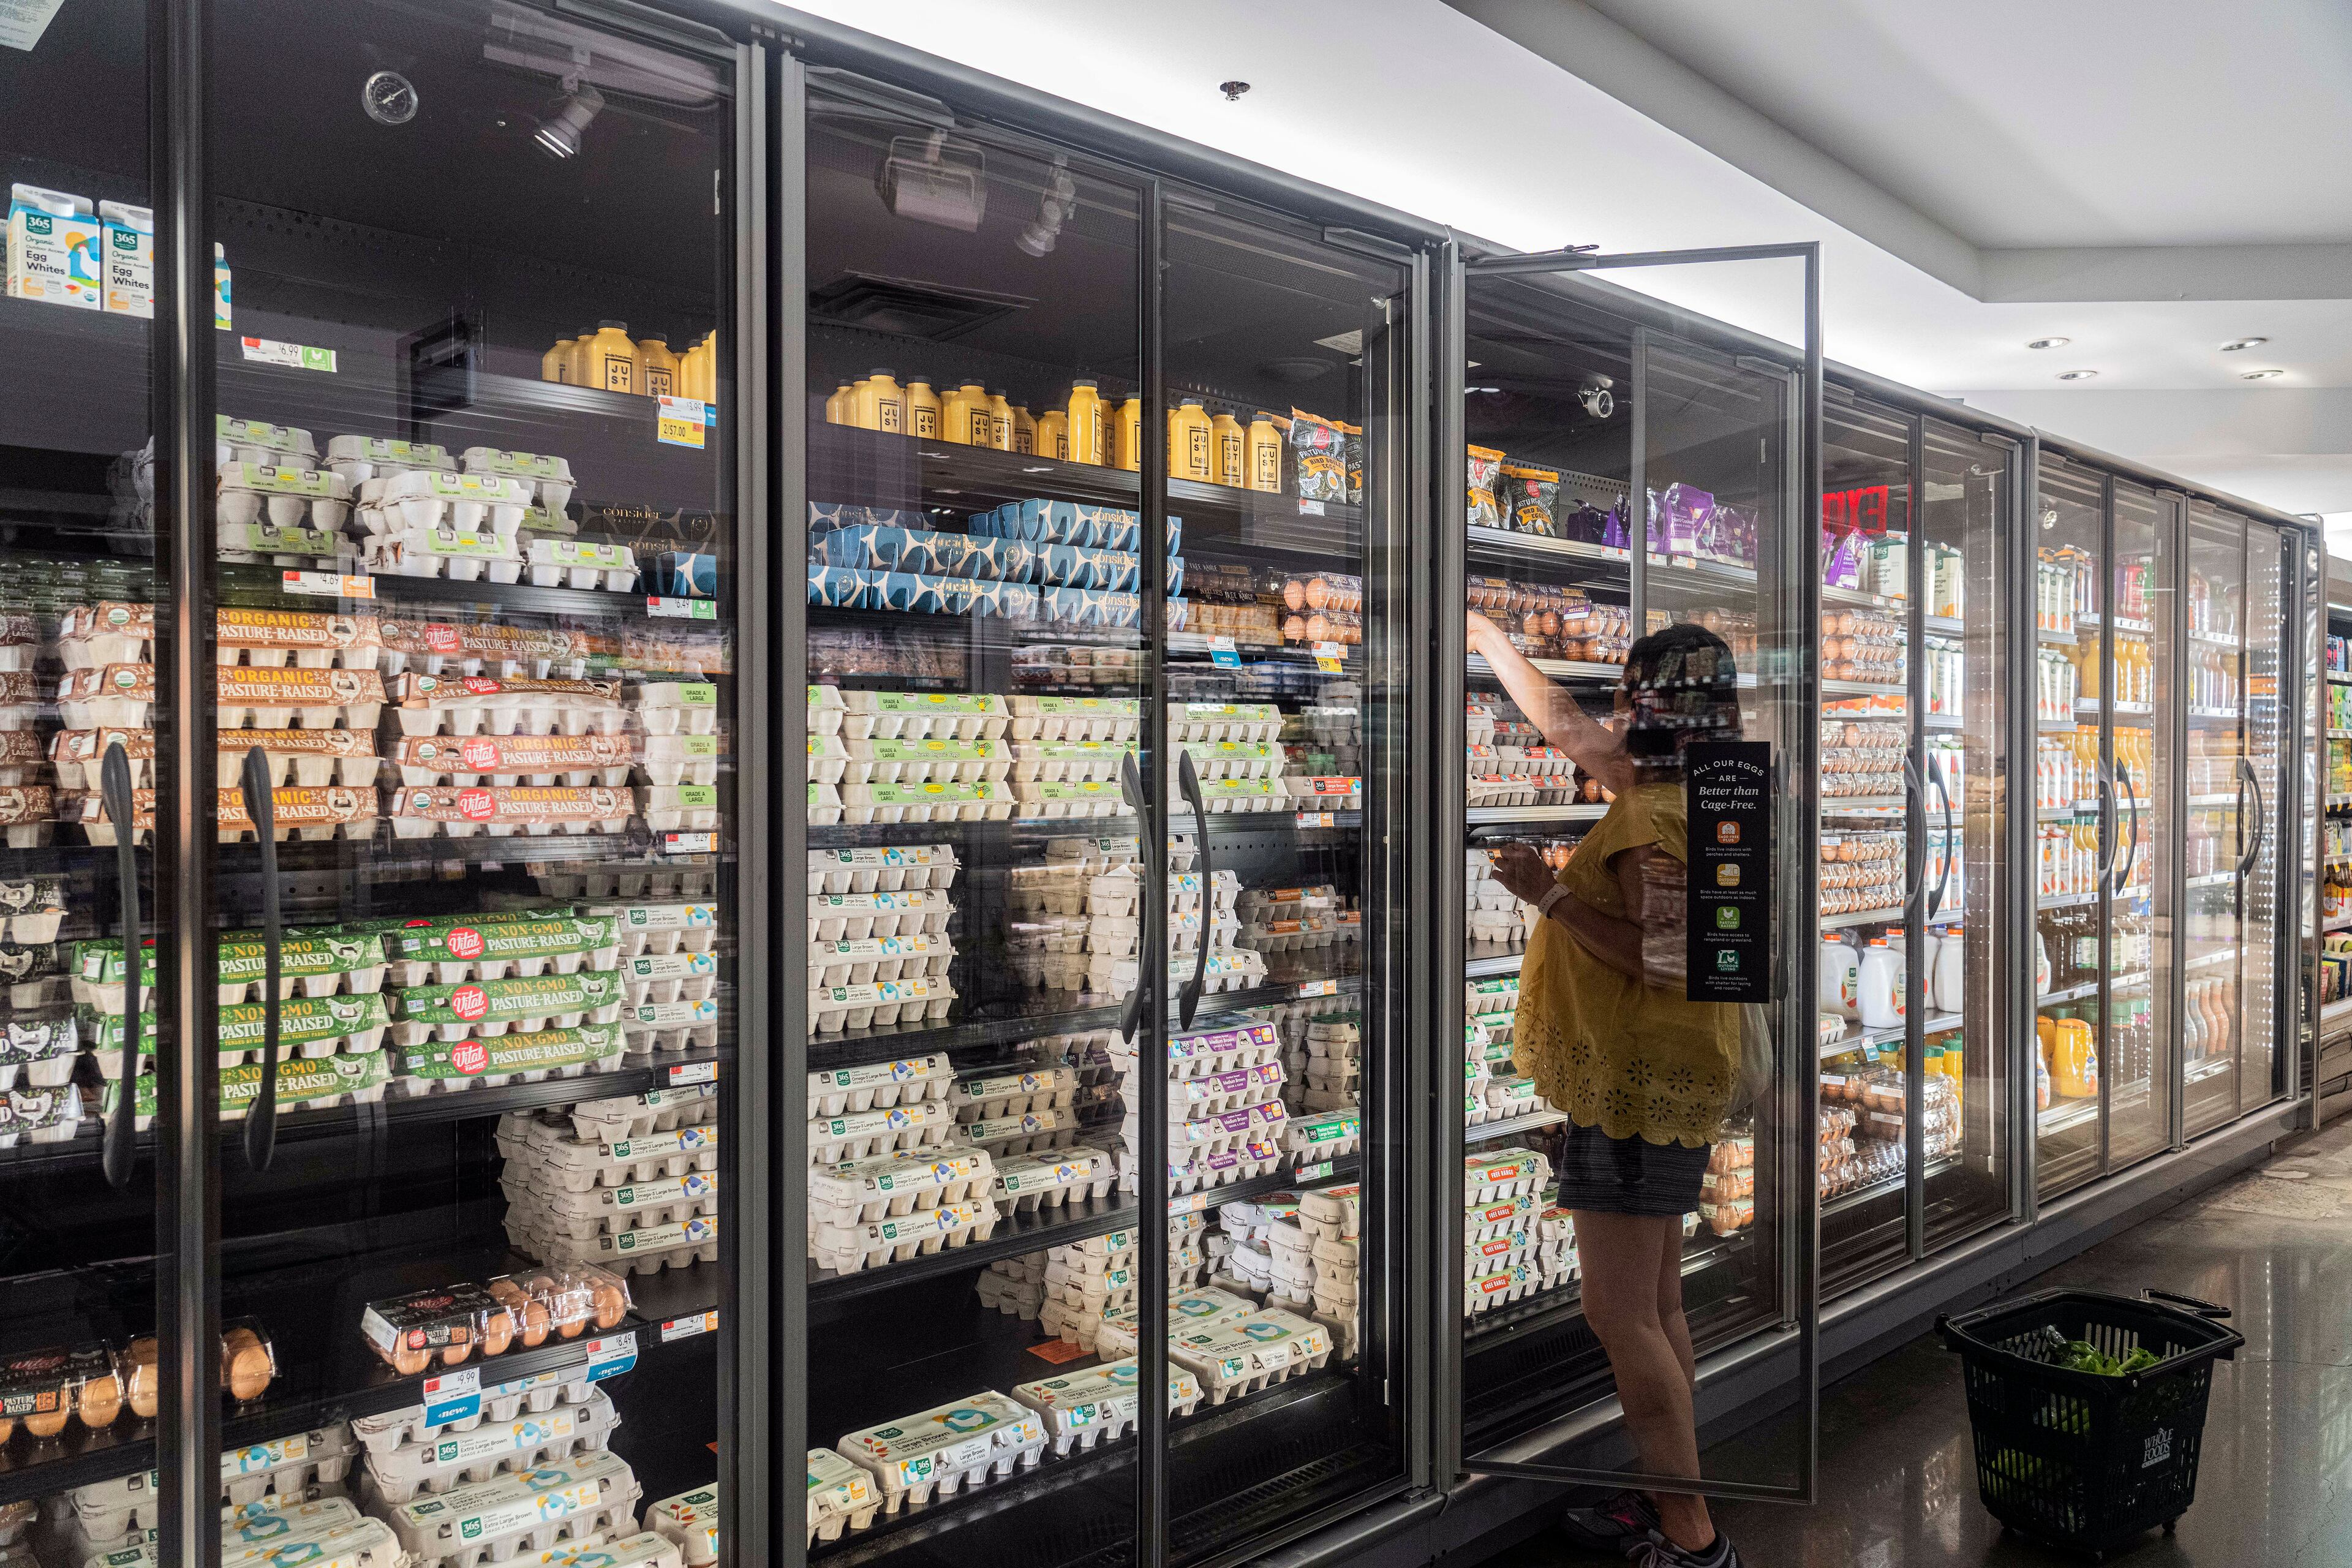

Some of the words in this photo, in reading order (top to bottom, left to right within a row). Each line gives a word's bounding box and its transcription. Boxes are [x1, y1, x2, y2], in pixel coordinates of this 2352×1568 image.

[28, 217, 50, 228] 365
[26, 235, 55, 246] Organic
[115, 233, 135, 244] 365
[26, 251, 47, 262] Egg
[112, 251, 139, 261] Organic
[26, 262, 65, 274] Whites
[113, 266, 132, 276] Egg
[113, 276, 149, 289] Whites
[279, 344, 298, 357] $6.99
[687, 402, 701, 412] $3.99
[603, 505, 662, 519] consider
[1091, 510, 1136, 524] consider
[628, 538, 687, 552] consider
[925, 534, 979, 549] consider
[1091, 553, 1137, 565] consider
[934, 579, 985, 593] consider
[229, 612, 309, 627] ORGANIC
[427, 629, 456, 645] Vital
[462, 637, 551, 652] PASTURE-RAISED
[235, 670, 314, 684] ORGANIC
[218, 684, 332, 698] PASTURE-RAISED
[513, 737, 578, 750] ORGANIC
[465, 748, 495, 766] Vital
[502, 750, 594, 764] PASTURE-RAISED
[1694, 764, 1711, 776] ALL
[1738, 761, 1764, 776] EGGS
[511, 789, 578, 801] ORGANIC
[1699, 786, 1732, 796] Better
[1734, 786, 1758, 796] than
[461, 799, 491, 813] Vital
[499, 802, 594, 814] PASTURE-RAISED
[1701, 800, 1756, 811] Cage-Free.
[499, 922, 562, 937] NON-GMO
[448, 933, 479, 952] Vital
[487, 933, 581, 951] PASTURE-RAISED
[503, 979, 566, 995] NON-GMO
[453, 990, 484, 1011] Vital
[491, 990, 584, 1011] PASTURE-RAISED
[503, 1031, 567, 1049] NON-GMO
[454, 1046, 484, 1066] Vital
[492, 1043, 586, 1065] PASTURE-RAISED
[616, 1334, 631, 1346] $8.49
[601, 1366, 621, 1375] new
[458, 1372, 475, 1384] $9.99
[4, 1395, 35, 1406] PASTURE
[6, 1404, 32, 1413] RAISED
[441, 1407, 465, 1418] new
[895, 1439, 921, 1449] Large
[922, 1432, 949, 1442] Brown
[2144, 1428, 2173, 1450] WHOLE
[441, 1445, 456, 1455] 365
[2144, 1441, 2170, 1461] FOODS
[917, 1460, 929, 1470] 365
[463, 1522, 480, 1532] 365
